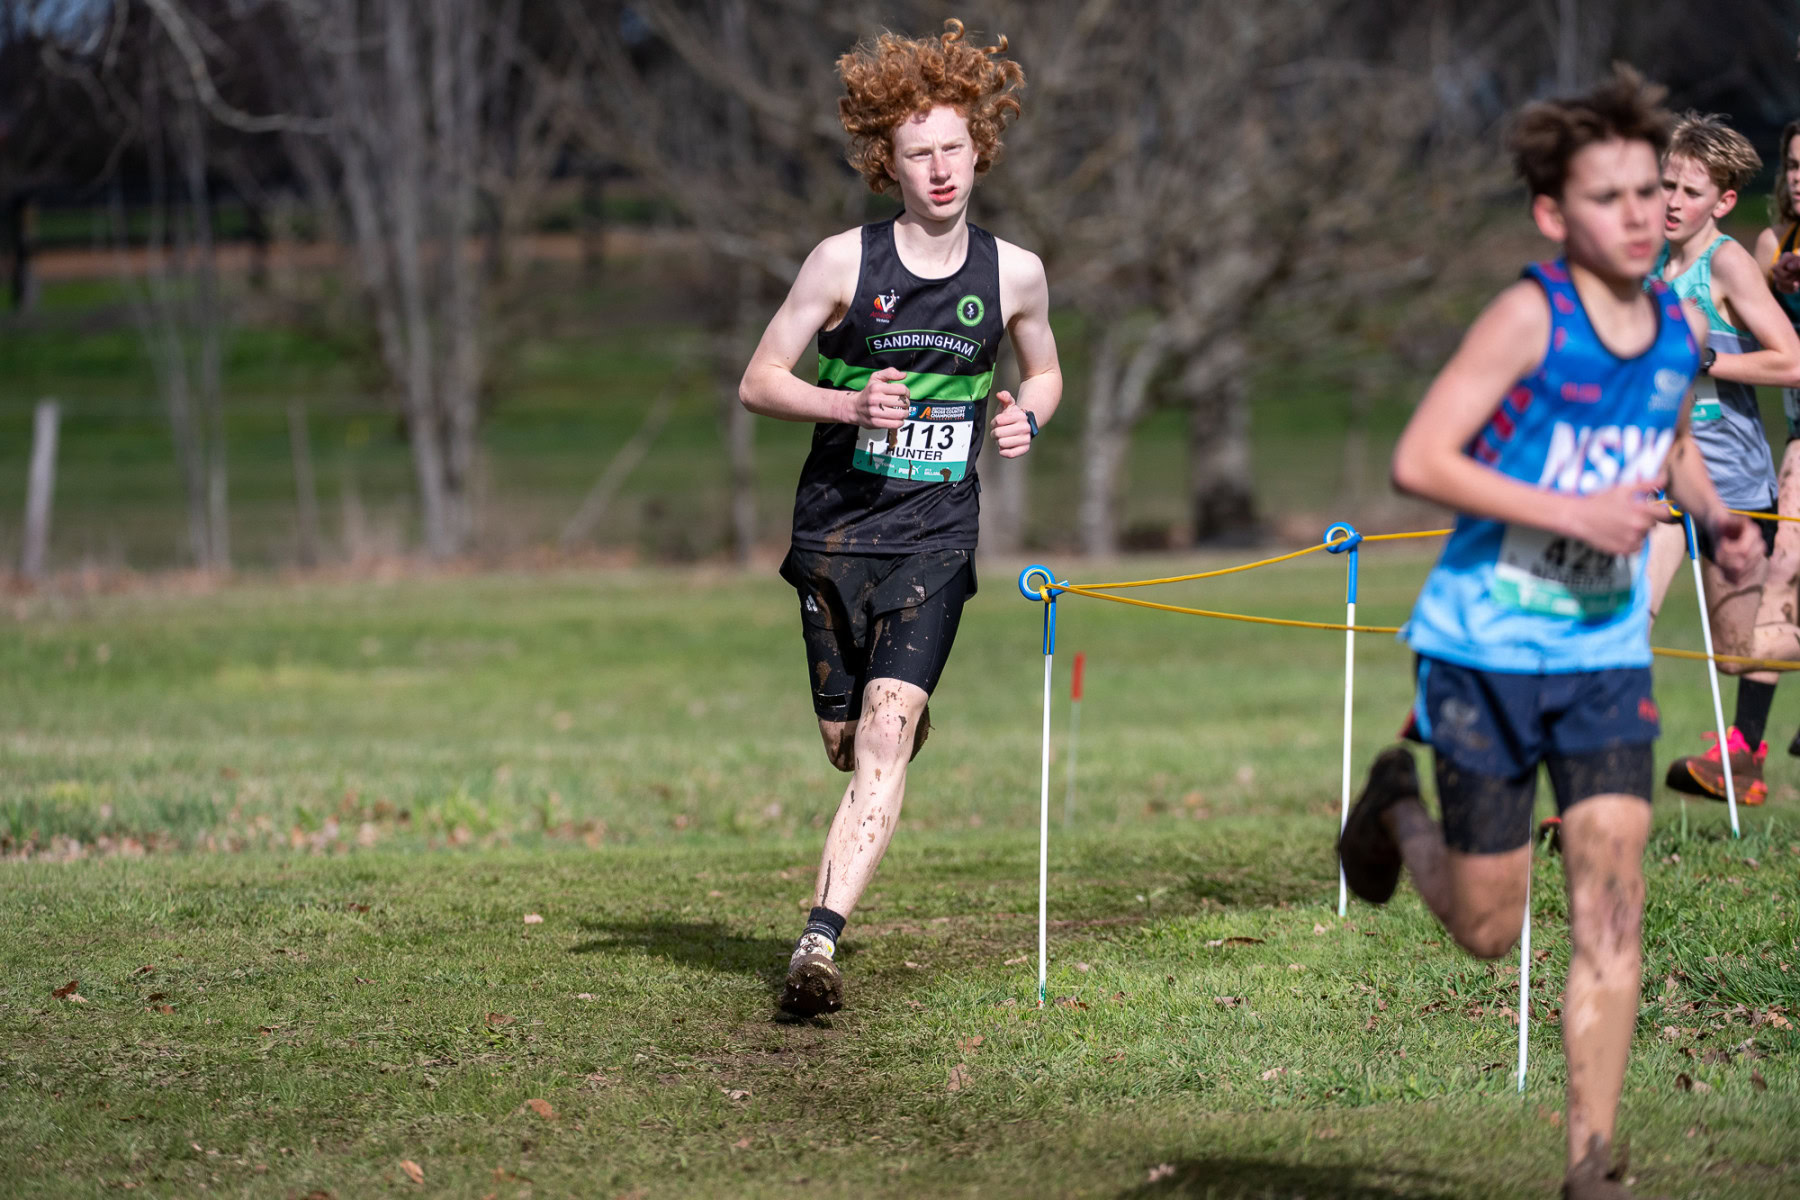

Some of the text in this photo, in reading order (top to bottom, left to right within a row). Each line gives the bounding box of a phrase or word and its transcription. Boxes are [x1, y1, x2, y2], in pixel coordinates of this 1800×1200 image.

[873, 334, 974, 357] SANDRINGHAM
[885, 422, 955, 450] 113
[886, 446, 943, 461] HUNTER
[1538, 421, 1675, 492] NSW
